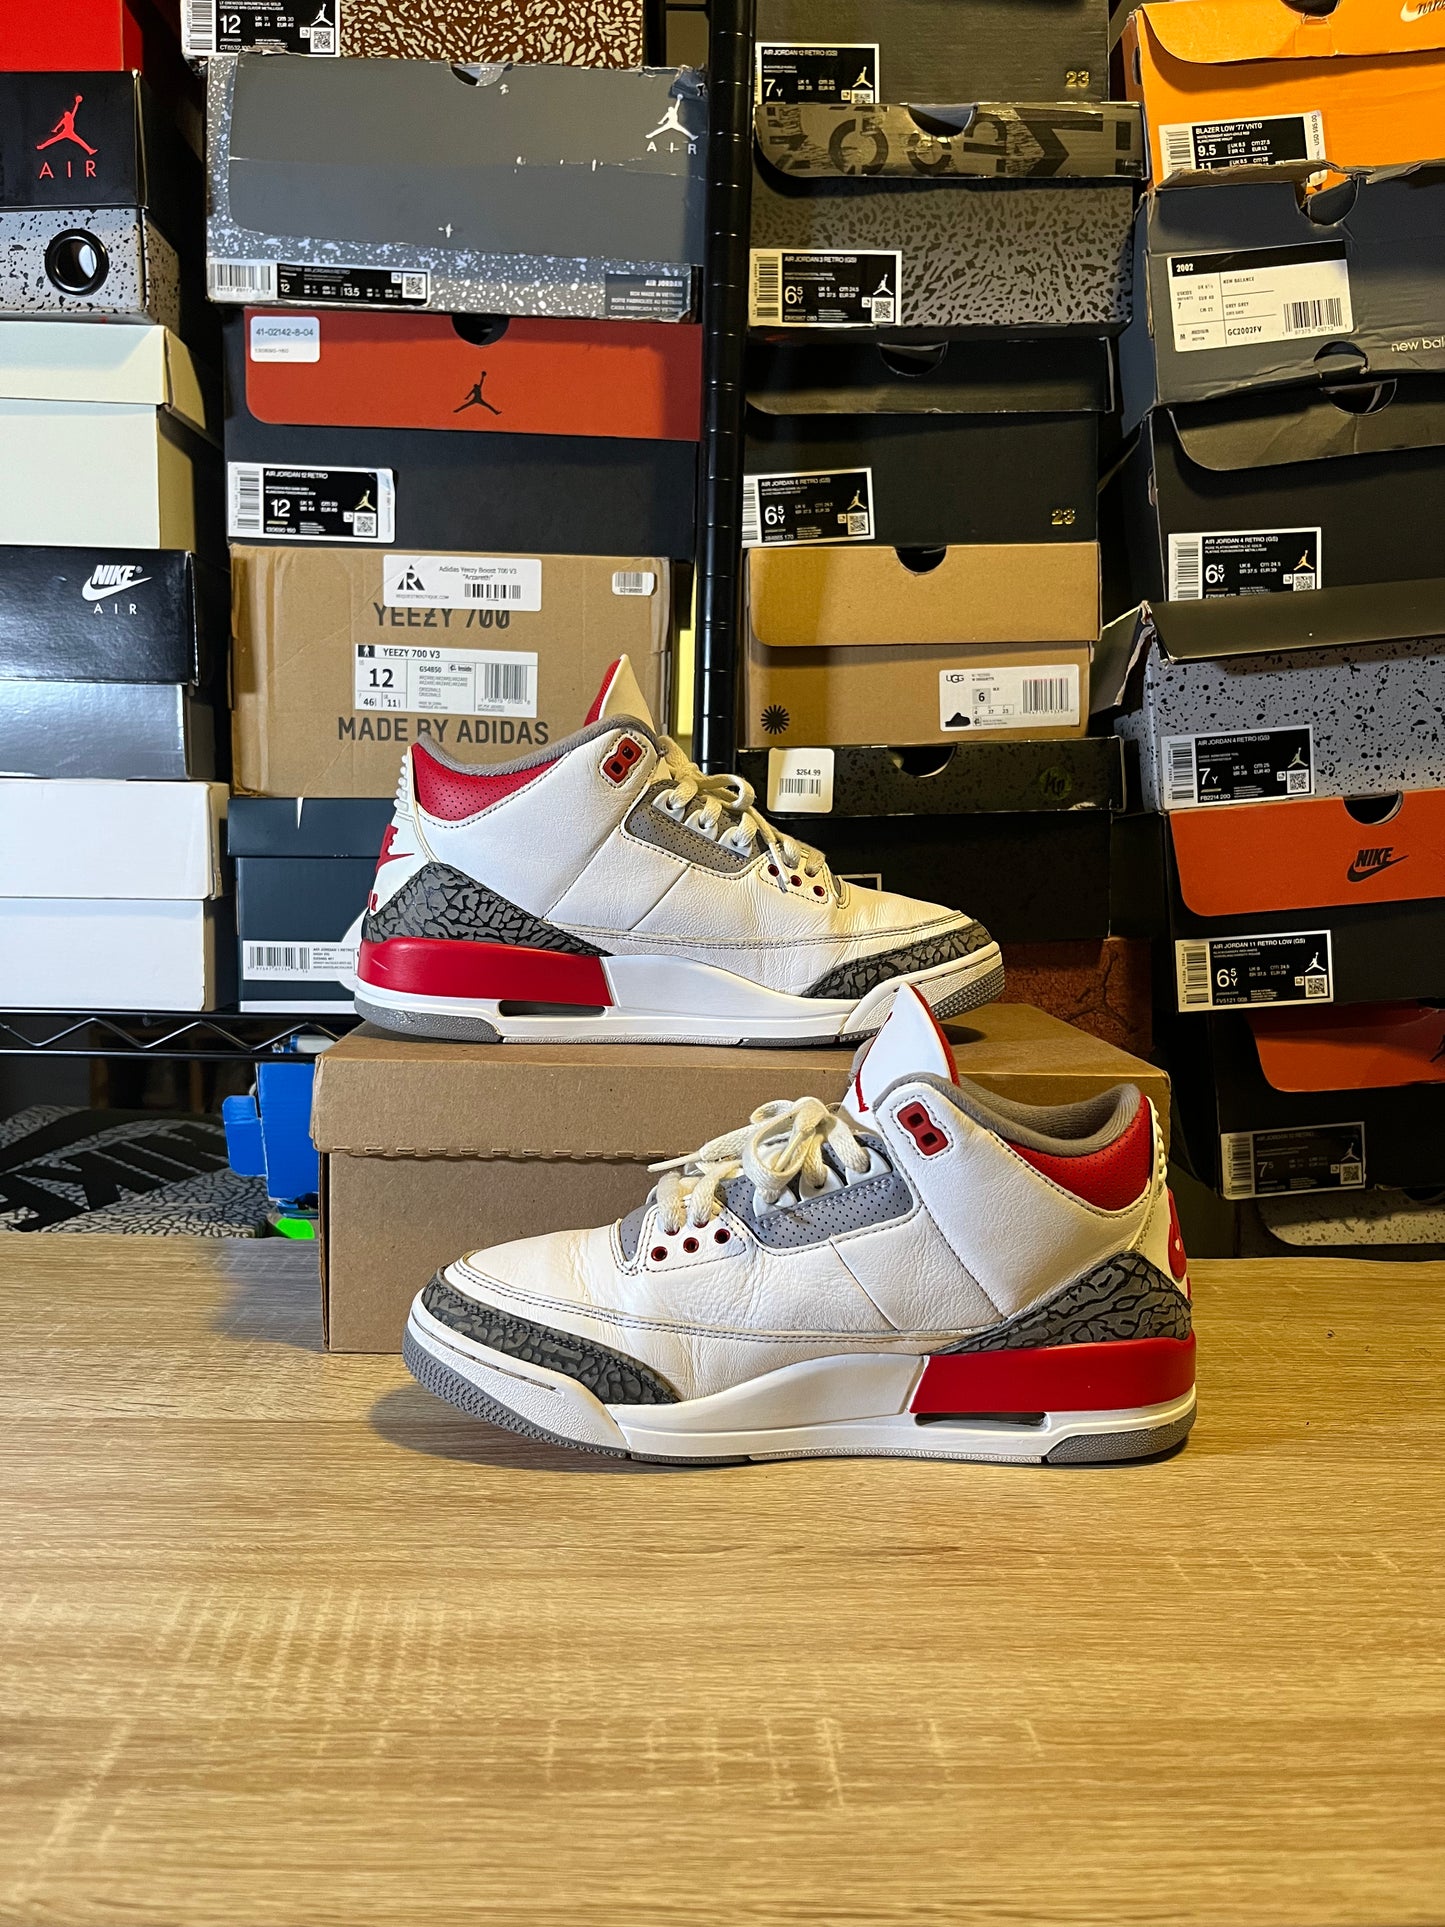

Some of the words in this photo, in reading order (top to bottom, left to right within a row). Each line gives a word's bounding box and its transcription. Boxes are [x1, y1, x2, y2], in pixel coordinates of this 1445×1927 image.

[219, 14, 241, 34] 12
[1066, 70, 1089, 88] 23
[763, 79, 776, 97] 7
[776, 88, 783, 97] Y
[1195, 126, 1220, 135] BLAZER
[646, 141, 697, 155] AIR
[1197, 144, 1217, 157] 9.5
[37, 160, 97, 179] AIR
[1175, 263, 1194, 273] 2002
[280, 283, 291, 293] 12
[343, 287, 360, 297] 13.5
[784, 286, 797, 304] 6
[797, 287, 803, 295] 5
[1227, 325, 1262, 336] GC2002FV
[1391, 341, 1419, 352] new
[270, 498, 291, 518] 12
[777, 505, 784, 514] 5
[764, 506, 778, 525] 6
[778, 515, 785, 524] Y
[1051, 508, 1076, 525] 23
[1215, 537, 1240, 545] JORDAN
[1205, 564, 1219, 584] 6
[1218, 564, 1224, 573] 5
[91, 564, 136, 586] NIKE
[1218, 573, 1225, 583] Y
[93, 603, 137, 615] AIR
[373, 602, 453, 628] YEEZY
[383, 648, 410, 657] YEEZY
[411, 649, 428, 658] 700
[429, 650, 441, 659] V3
[369, 667, 394, 688] 12
[945, 674, 965, 684] UGG
[363, 698, 375, 706] 46
[387, 699, 397, 707] 11
[978, 692, 985, 702] 6
[338, 716, 409, 742] MADE
[456, 719, 550, 745] ADIDAS
[1236, 735, 1257, 743] RETRO
[1199, 767, 1211, 785] 7
[1211, 775, 1218, 784] Y
[1354, 846, 1394, 868] NIKE
[1216, 968, 1230, 988] 6
[1230, 967, 1237, 977] 5
[1230, 977, 1238, 987] Y
[1257, 1161, 1268, 1178] 7
